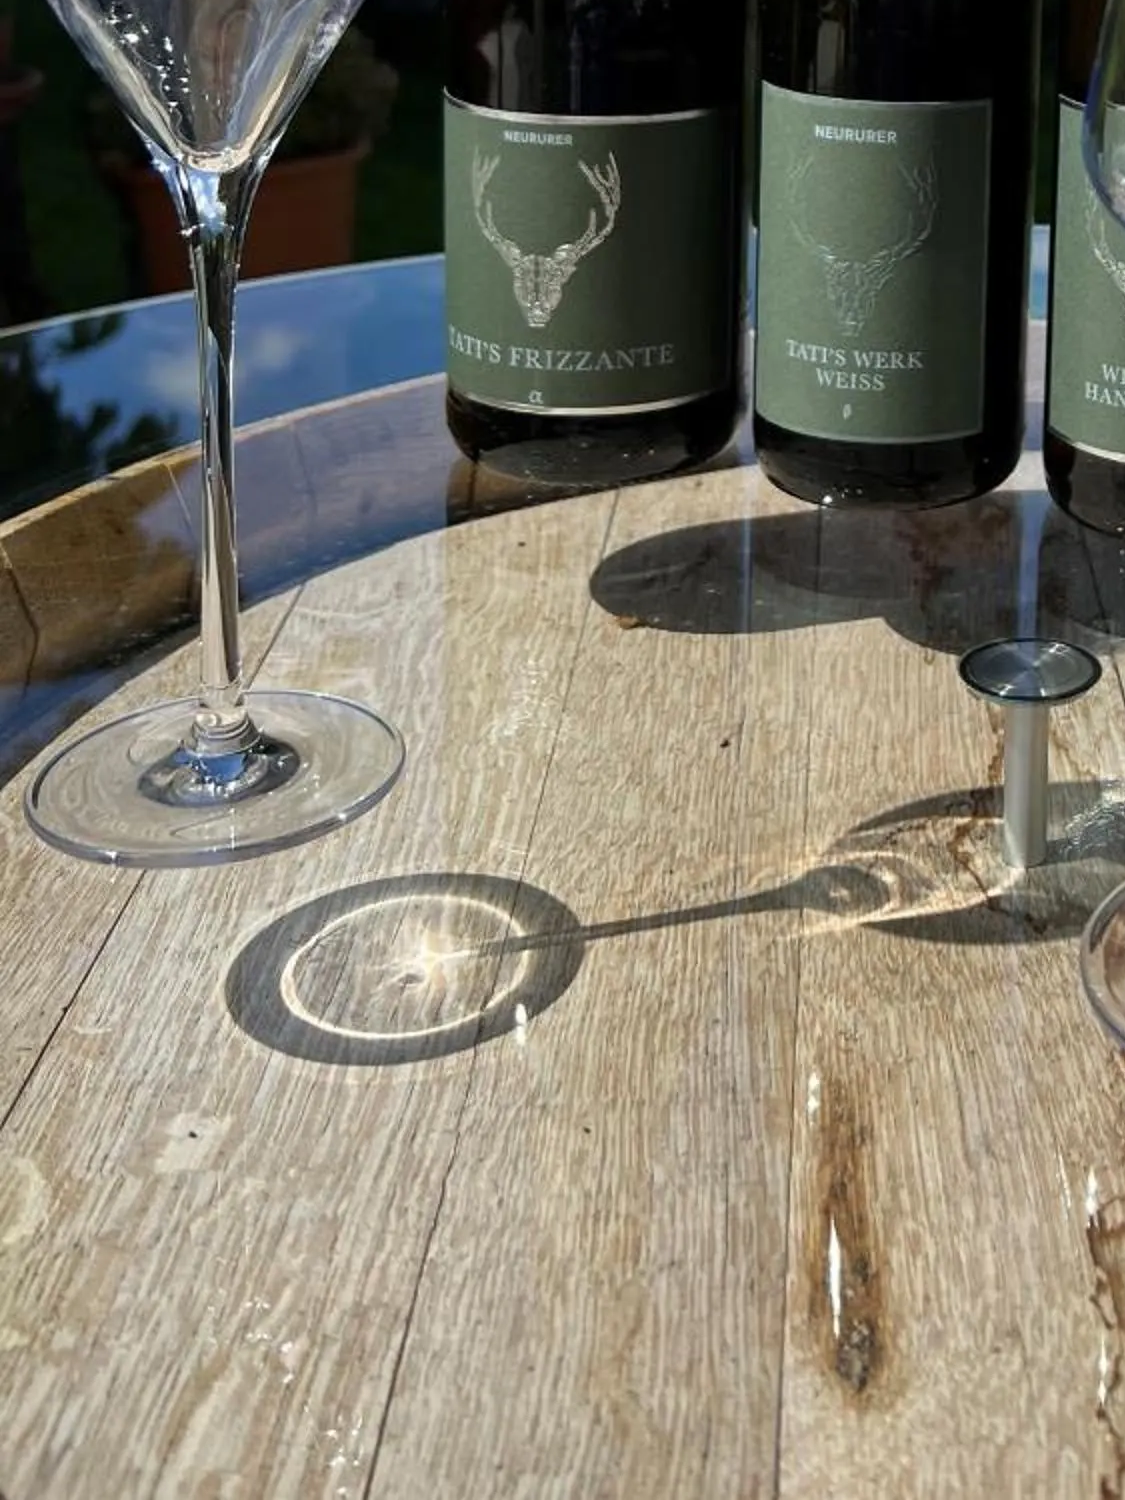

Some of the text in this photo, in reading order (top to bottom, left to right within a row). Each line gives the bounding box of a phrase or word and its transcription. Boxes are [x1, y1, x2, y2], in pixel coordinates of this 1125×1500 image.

[503, 130, 573, 146] NEURURER
[814, 124, 897, 144] NEURURER
[510, 344, 675, 371] FRIZZANTE
[786, 339, 924, 370] TATI'S WERK
[815, 368, 886, 391] WEISS
